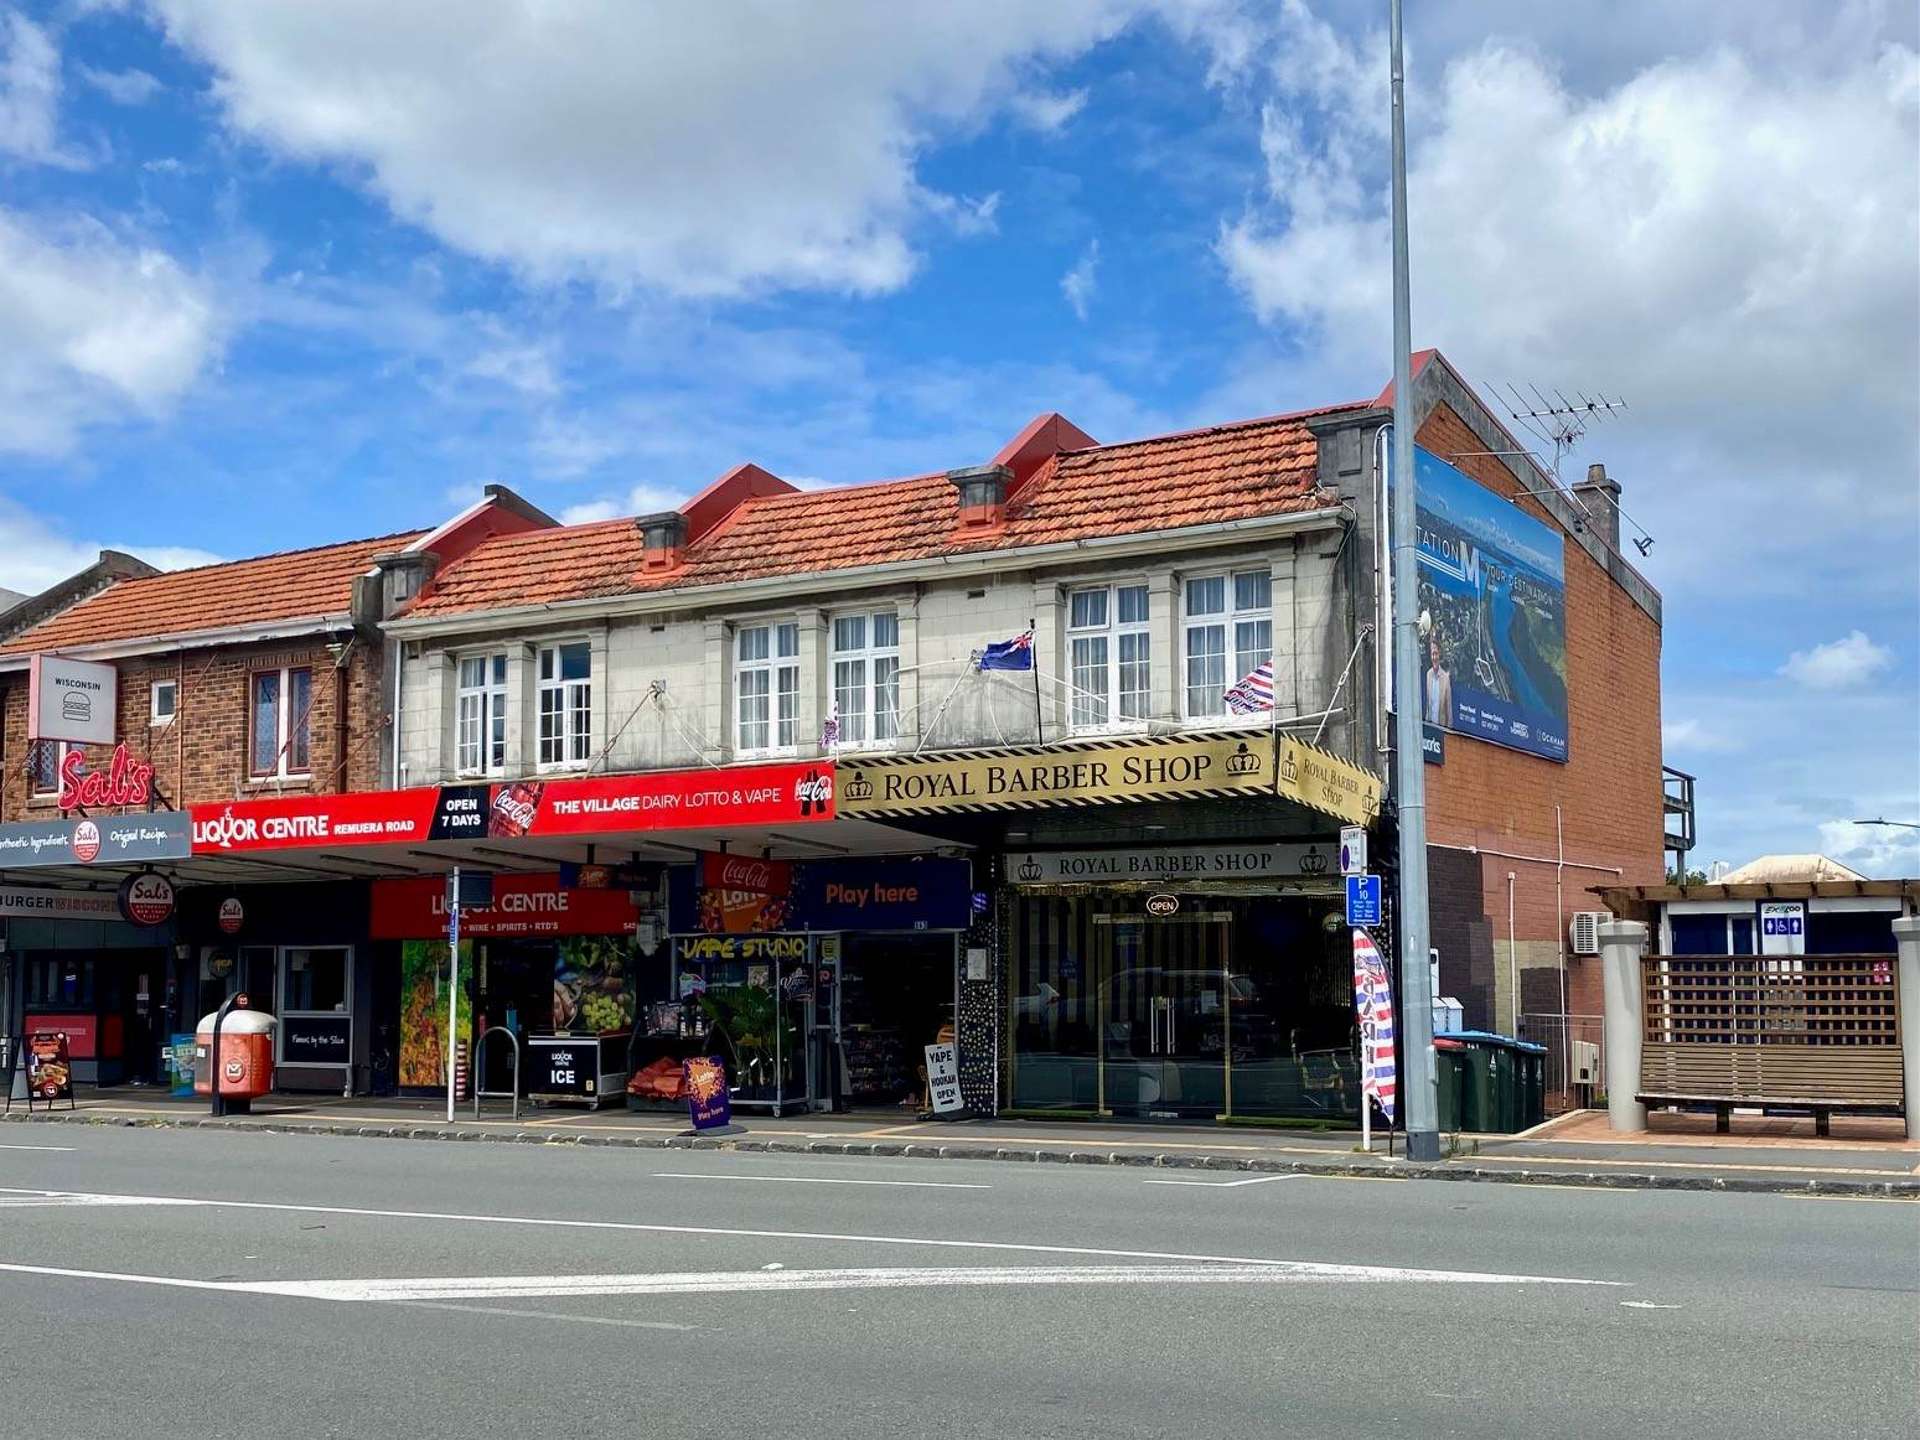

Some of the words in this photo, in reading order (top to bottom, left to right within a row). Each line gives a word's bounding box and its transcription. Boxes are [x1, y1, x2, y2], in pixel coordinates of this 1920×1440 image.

[1416, 525, 1460, 563] TATION
[55, 678, 101, 691] WISCONSIN
[58, 744, 151, 810] Sal's
[884, 773, 975, 800] ROYAL
[987, 761, 1110, 794] BARBER
[1122, 755, 1212, 784] SHOP
[1304, 758, 1329, 783] ROYAL
[1330, 769, 1359, 794] BARBER
[446, 799, 477, 811] OPEN
[553, 801, 579, 815] THE
[582, 796, 640, 813] VILLAGE
[643, 794, 681, 809] DAIRY
[685, 792, 729, 807] LOTTO
[732, 791, 742, 804] &
[745, 788, 781, 803] VAPE
[1321, 785, 1344, 808] SHOP
[193, 809, 258, 848] LIQUOR
[262, 815, 329, 840] CENTRE
[334, 821, 383, 835] REMUERA
[385, 820, 414, 832] ROAD
[442, 816, 449, 827] 7
[451, 814, 480, 826] DAYS
[1060, 857, 1122, 875] ROYAL
[1128, 854, 1211, 873] BARBER
[1215, 853, 1272, 869] SHOP
[134, 882, 170, 899] Sal's
[1358, 878, 1369, 890] P
[501, 892, 569, 912] CENTRE
[826, 884, 869, 907] Play
[874, 883, 919, 903] here
[1151, 901, 1175, 911] OPEN
[496, 922, 528, 932] SPIRITS
[680, 938, 735, 959] VAPE
[741, 937, 806, 958] STUDIO
[929, 1050, 953, 1063] VAPE
[551, 1070, 576, 1084] ICE
[936, 1088, 956, 1099] OPEN
